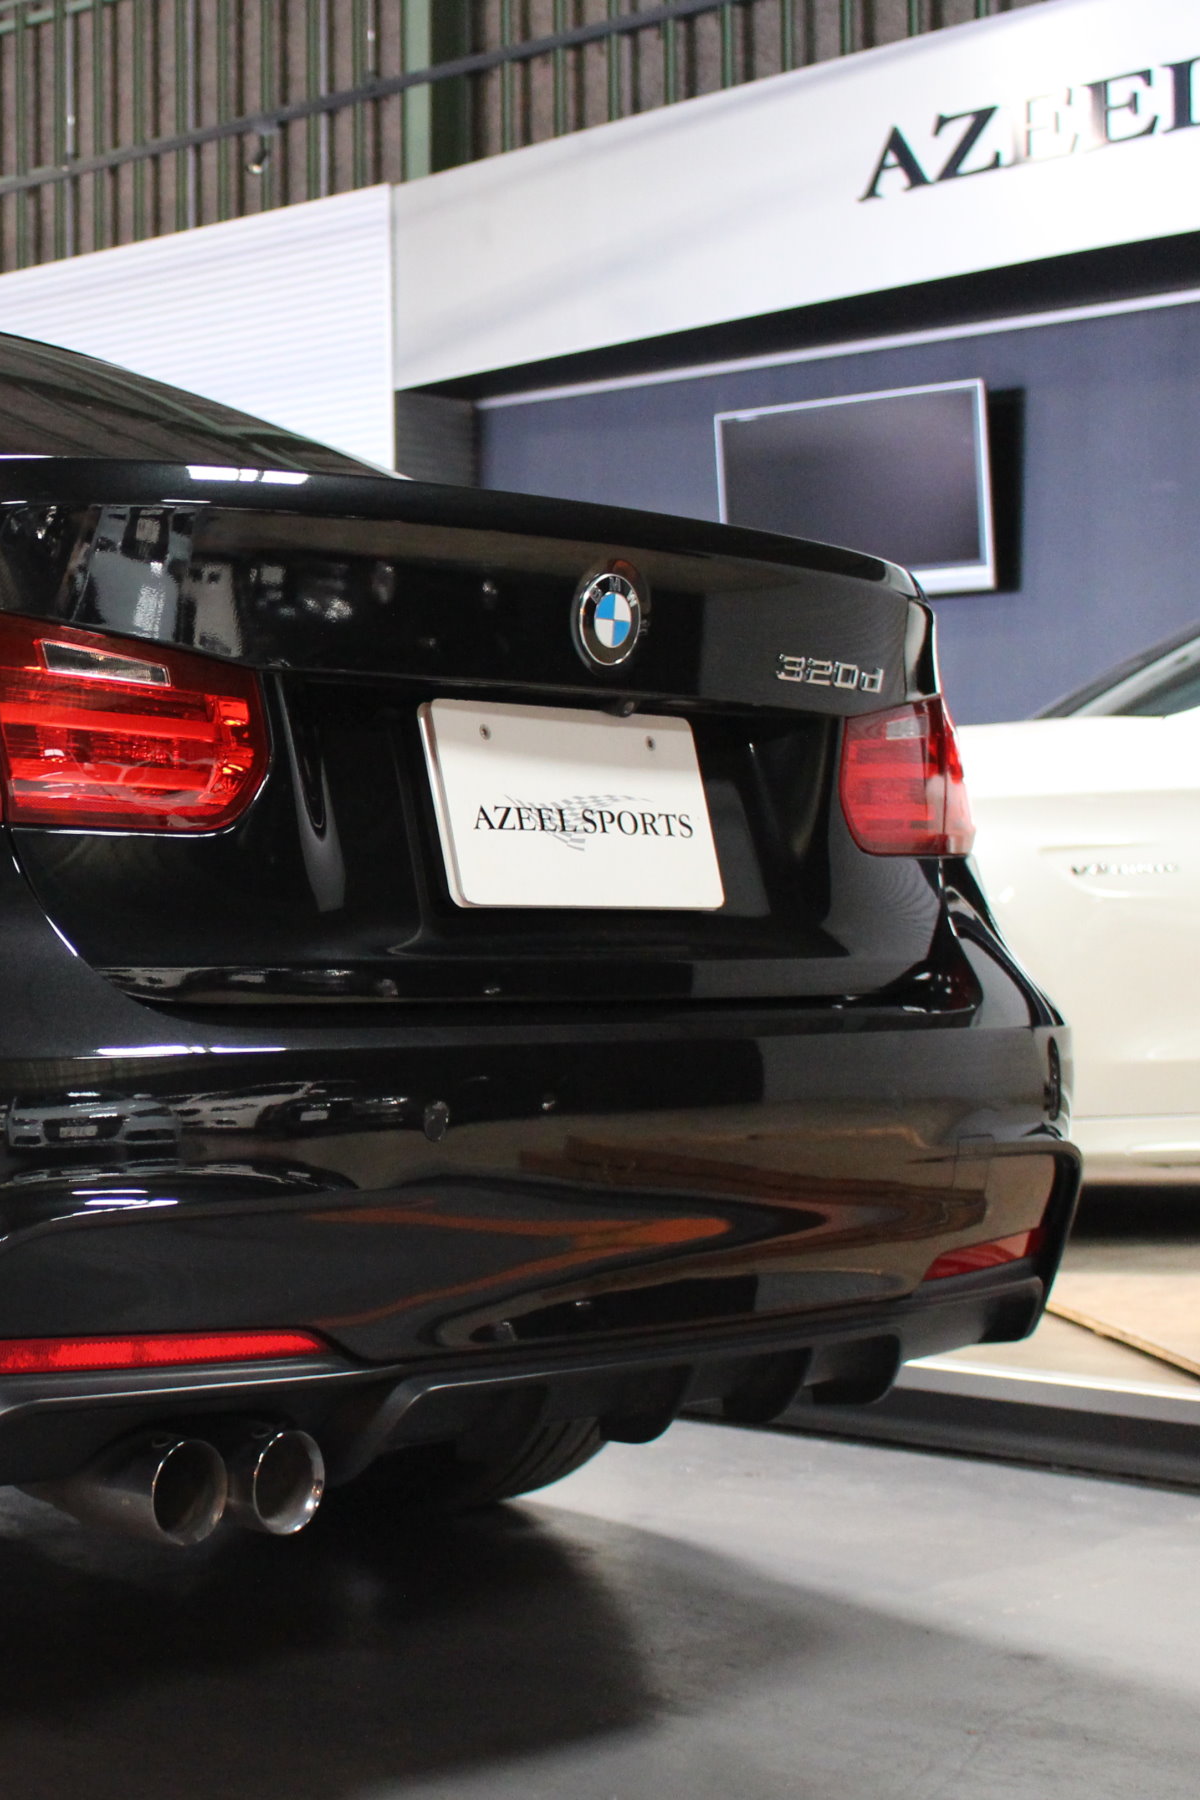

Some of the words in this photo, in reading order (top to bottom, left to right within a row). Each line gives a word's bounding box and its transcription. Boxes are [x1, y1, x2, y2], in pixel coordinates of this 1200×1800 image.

[775, 653, 884, 693] 320d
[473, 805, 578, 832] AZEEL
[583, 809, 694, 838] SPORTS
